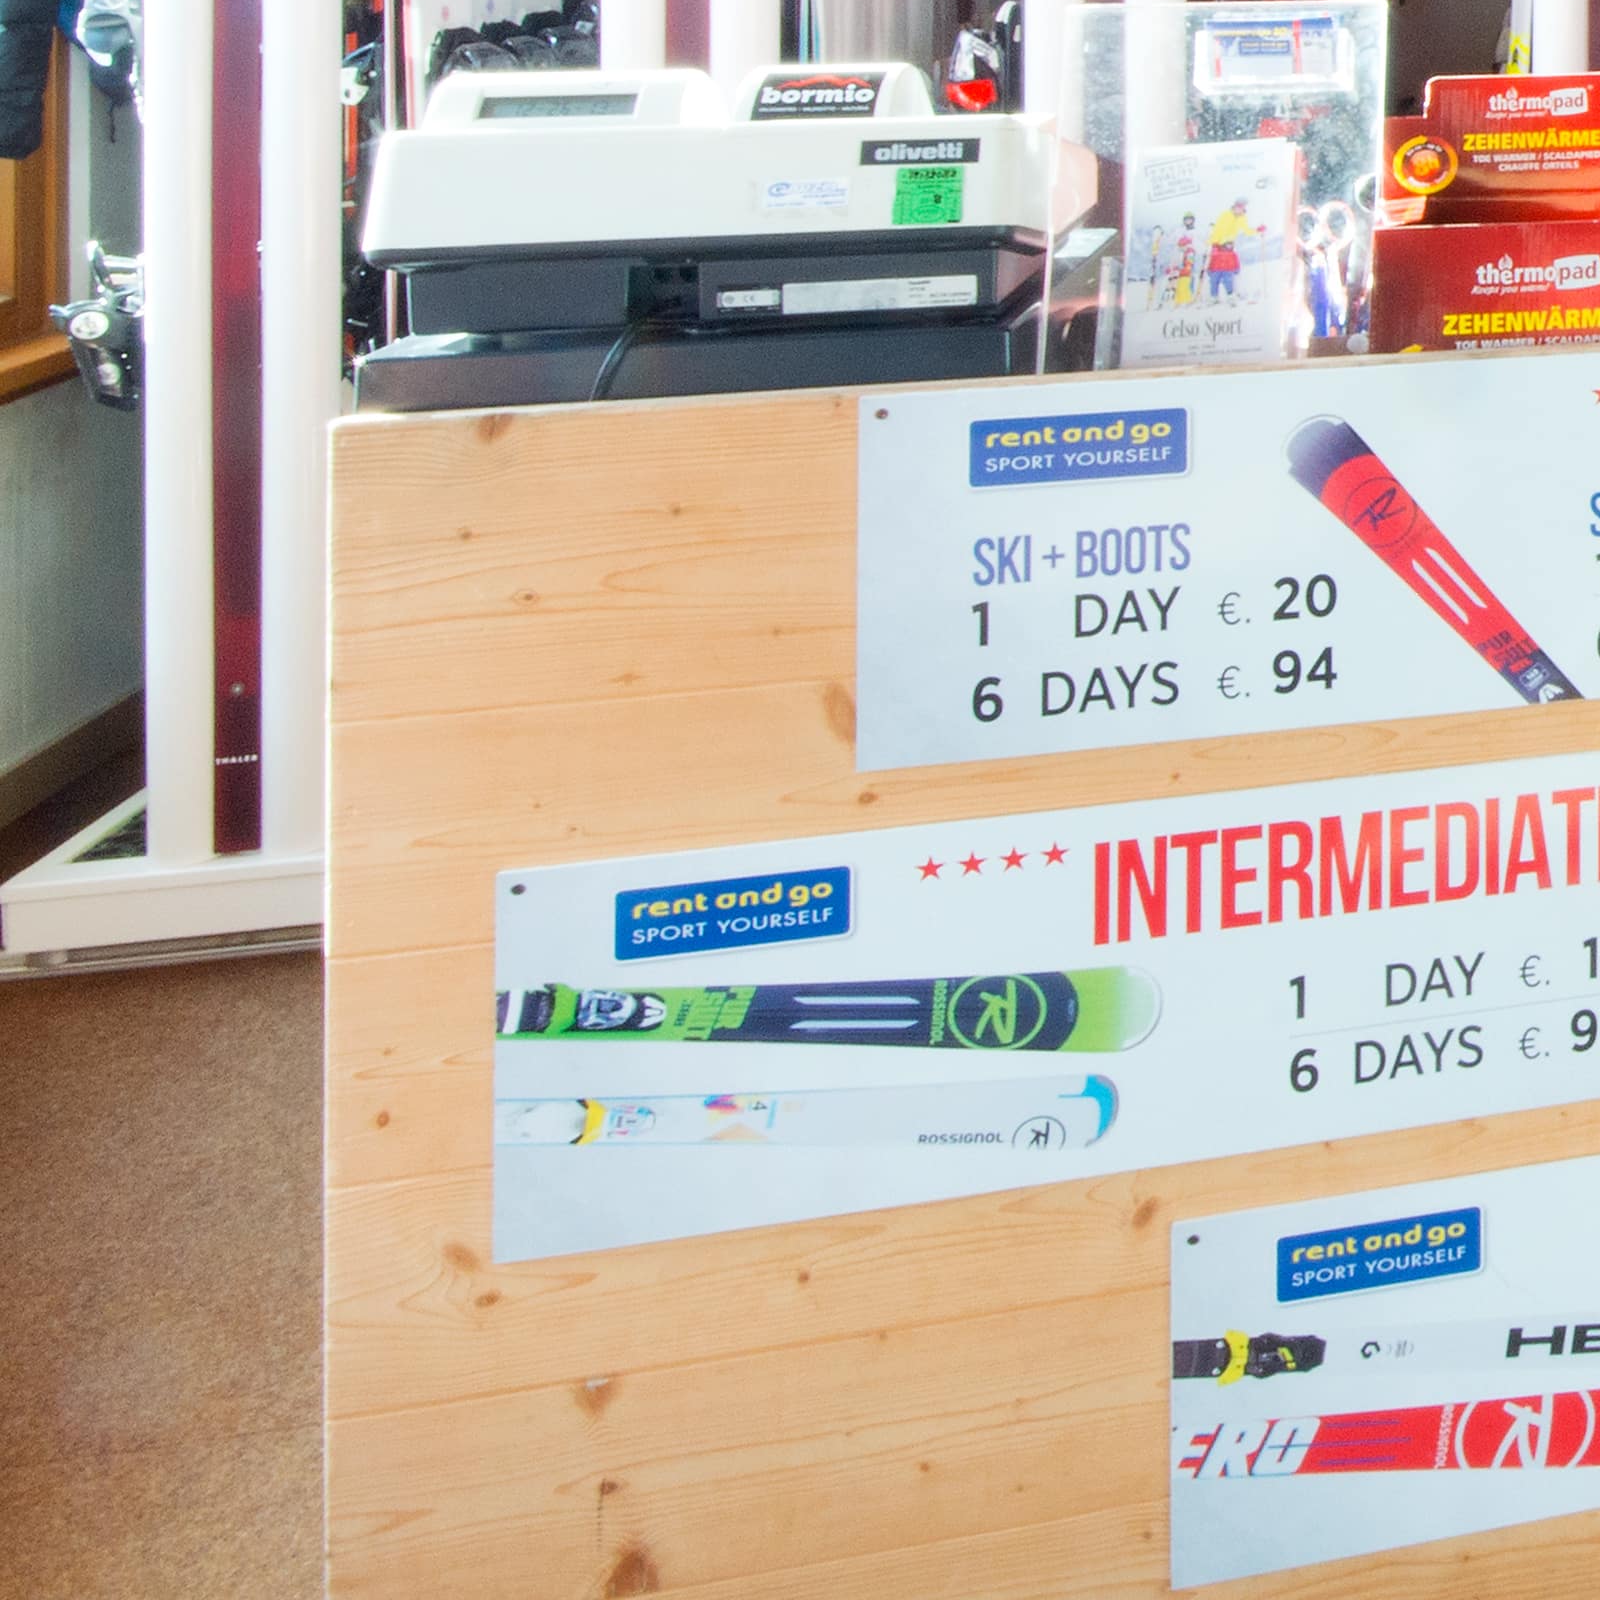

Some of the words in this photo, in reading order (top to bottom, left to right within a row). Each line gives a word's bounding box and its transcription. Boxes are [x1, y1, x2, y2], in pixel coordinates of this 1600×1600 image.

[760, 83, 876, 105] bormio
[873, 141, 964, 162] olivetti
[1472, 154, 1492, 164] TOE
[1493, 151, 1537, 163] WARMER
[1498, 162, 1541, 173] CHAUFFE
[1542, 160, 1580, 171] ORTEILS
[1204, 316, 1243, 342] Sport
[1480, 337, 1535, 350] WARMER
[986, 424, 1054, 450] rent
[1062, 420, 1125, 444] and
[1129, 420, 1173, 445] go
[985, 453, 1056, 473] SPORT
[1062, 442, 1172, 468] YOURSELF
[972, 536, 1031, 587] SKI
[1041, 544, 1067, 575] +
[1077, 525, 1190, 577] BOOTS
[971, 601, 989, 647] 1
[1074, 585, 1181, 639] DAY
[1272, 573, 1338, 622] 20
[971, 676, 1004, 723] 6
[1040, 660, 1180, 718] DAYS
[1272, 646, 1338, 695] 94
[633, 886, 708, 920] rent
[716, 881, 784, 911] and
[788, 881, 834, 912] go
[632, 922, 707, 944] SPORT
[717, 907, 837, 938] YOURSELF
[1289, 975, 1306, 1020] 1
[1385, 951, 1485, 1008] DAY
[1289, 1047, 1319, 1094] 6
[1354, 1024, 1484, 1085] DAYS
[917, 1131, 1004, 1145] ROSSIGNOL
[1292, 1238, 1356, 1263] rent
[1363, 1228, 1418, 1251] and
[1427, 1223, 1465, 1246] go
[1292, 1263, 1356, 1287] SPORT
[1364, 1245, 1467, 1274] YOURSELF
